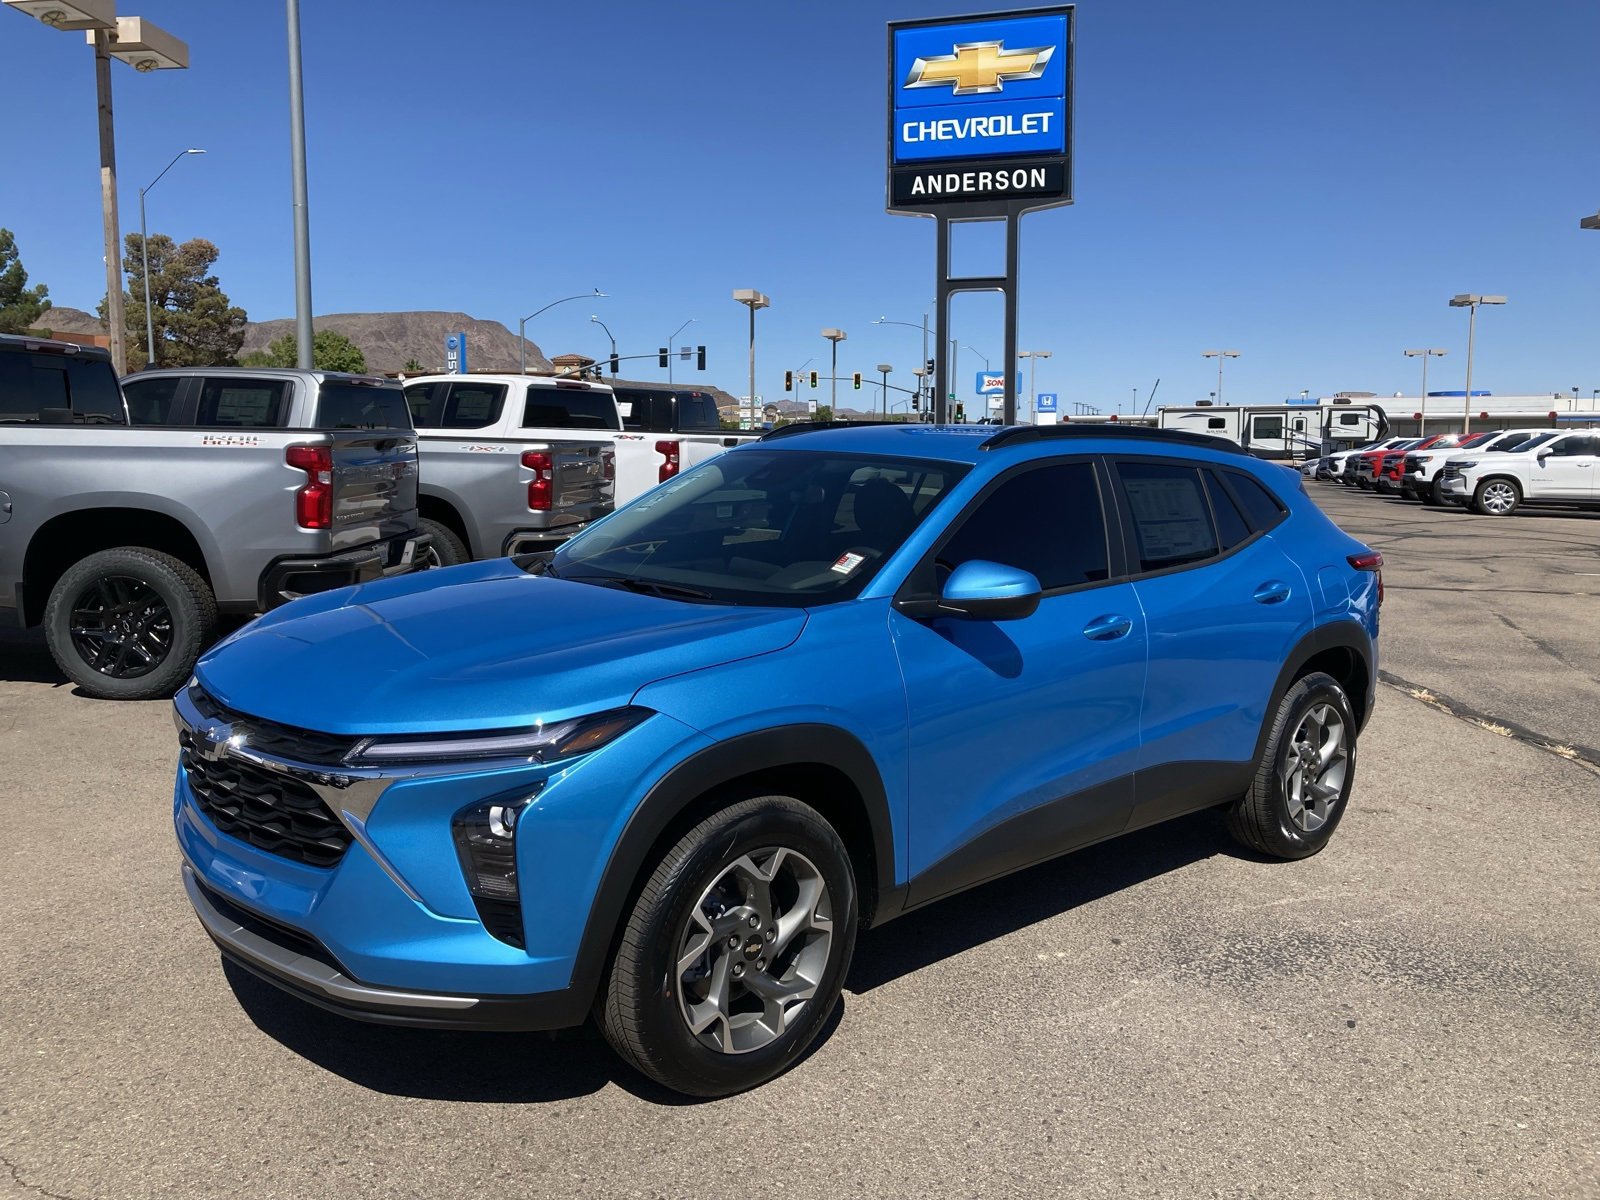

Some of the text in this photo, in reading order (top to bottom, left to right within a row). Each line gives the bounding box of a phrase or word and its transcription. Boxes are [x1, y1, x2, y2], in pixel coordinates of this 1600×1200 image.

[903, 112, 1054, 142] CHEVROLET
[911, 168, 1046, 195] ANDERSON
[986, 379, 1004, 387] SON
